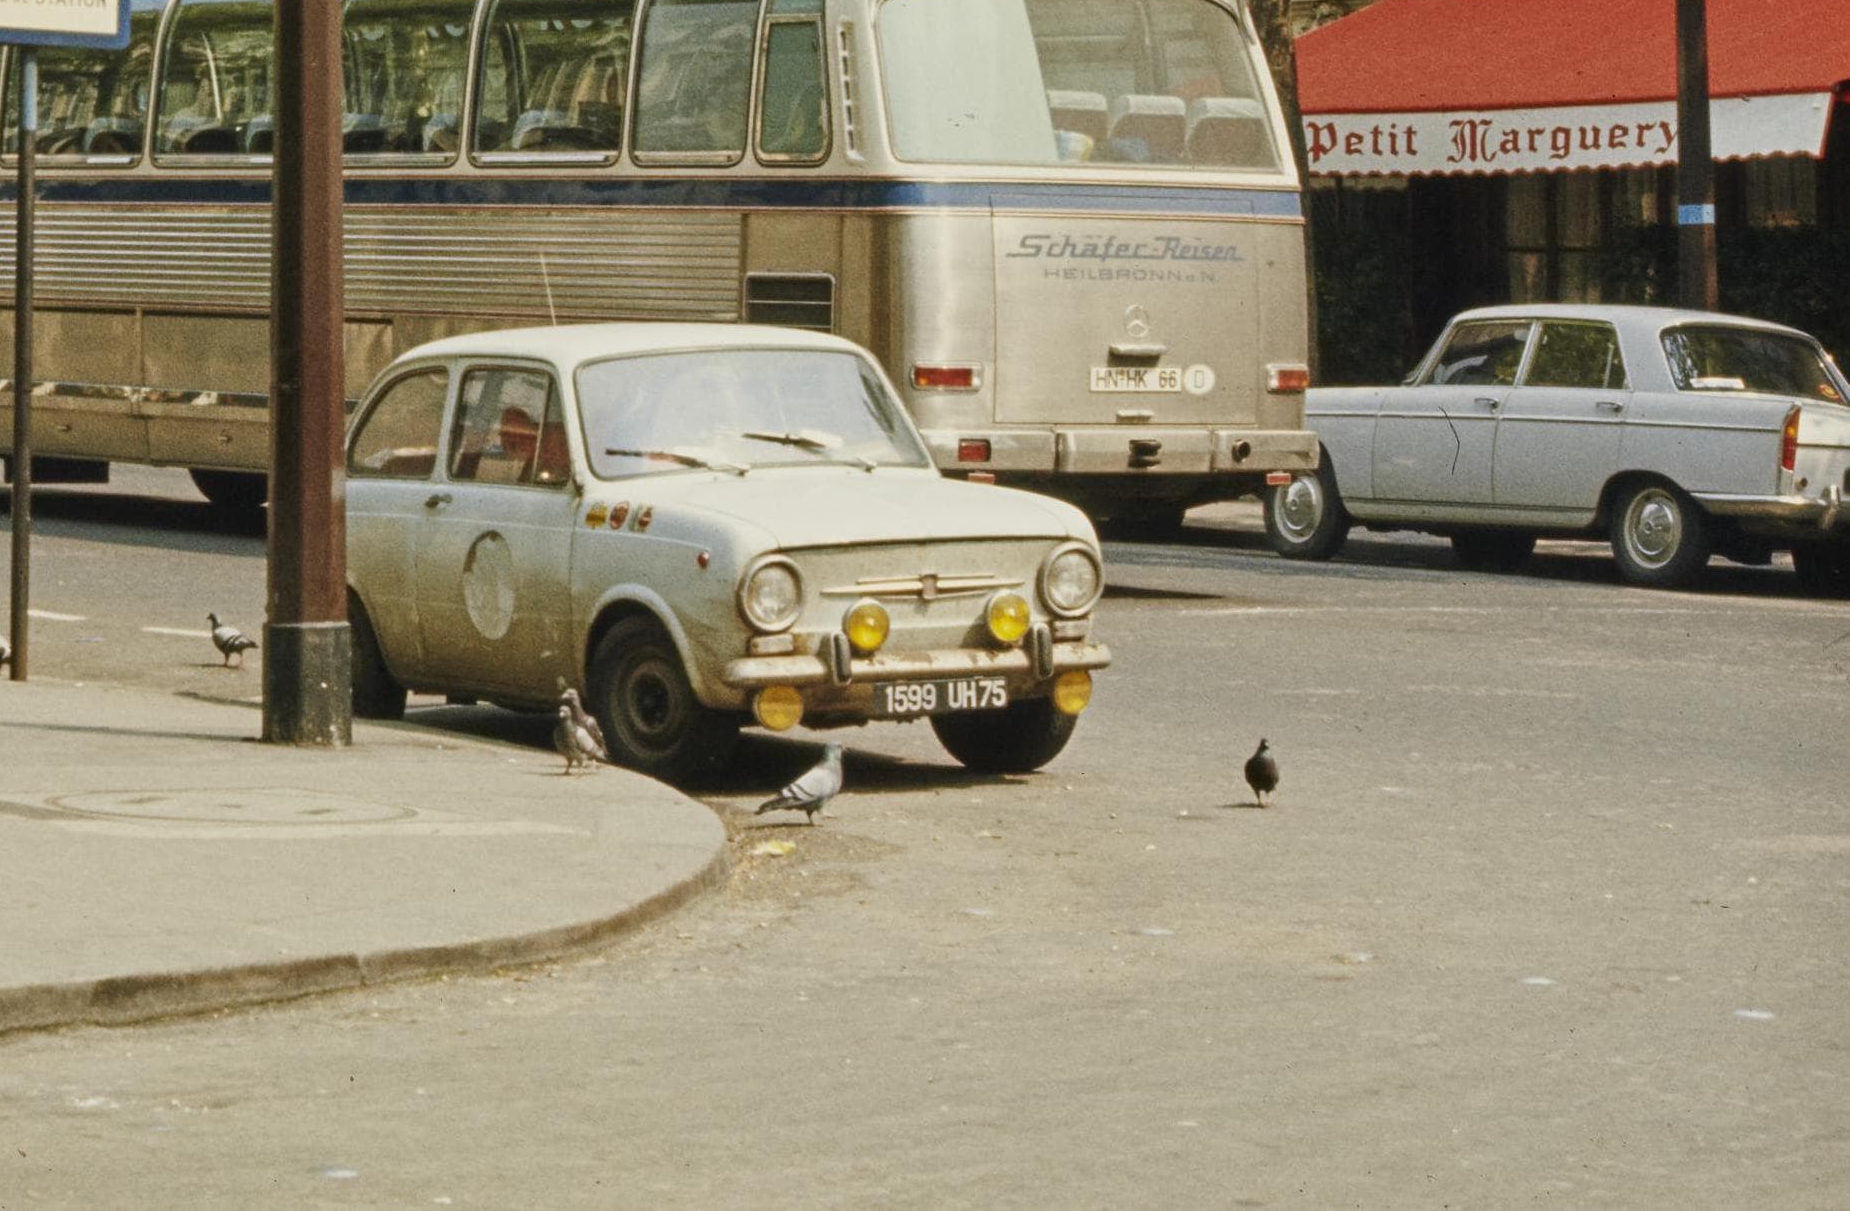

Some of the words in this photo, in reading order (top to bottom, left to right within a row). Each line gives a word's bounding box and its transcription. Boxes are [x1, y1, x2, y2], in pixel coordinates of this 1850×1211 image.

[1306, 120, 1418, 164] Petit
[1447, 118, 1678, 163] Marguery
[1044, 268, 1182, 281] HEILBRONN
[1158, 370, 1177, 388] 66
[1194, 370, 1205, 388] D
[886, 683, 937, 713] 1599
